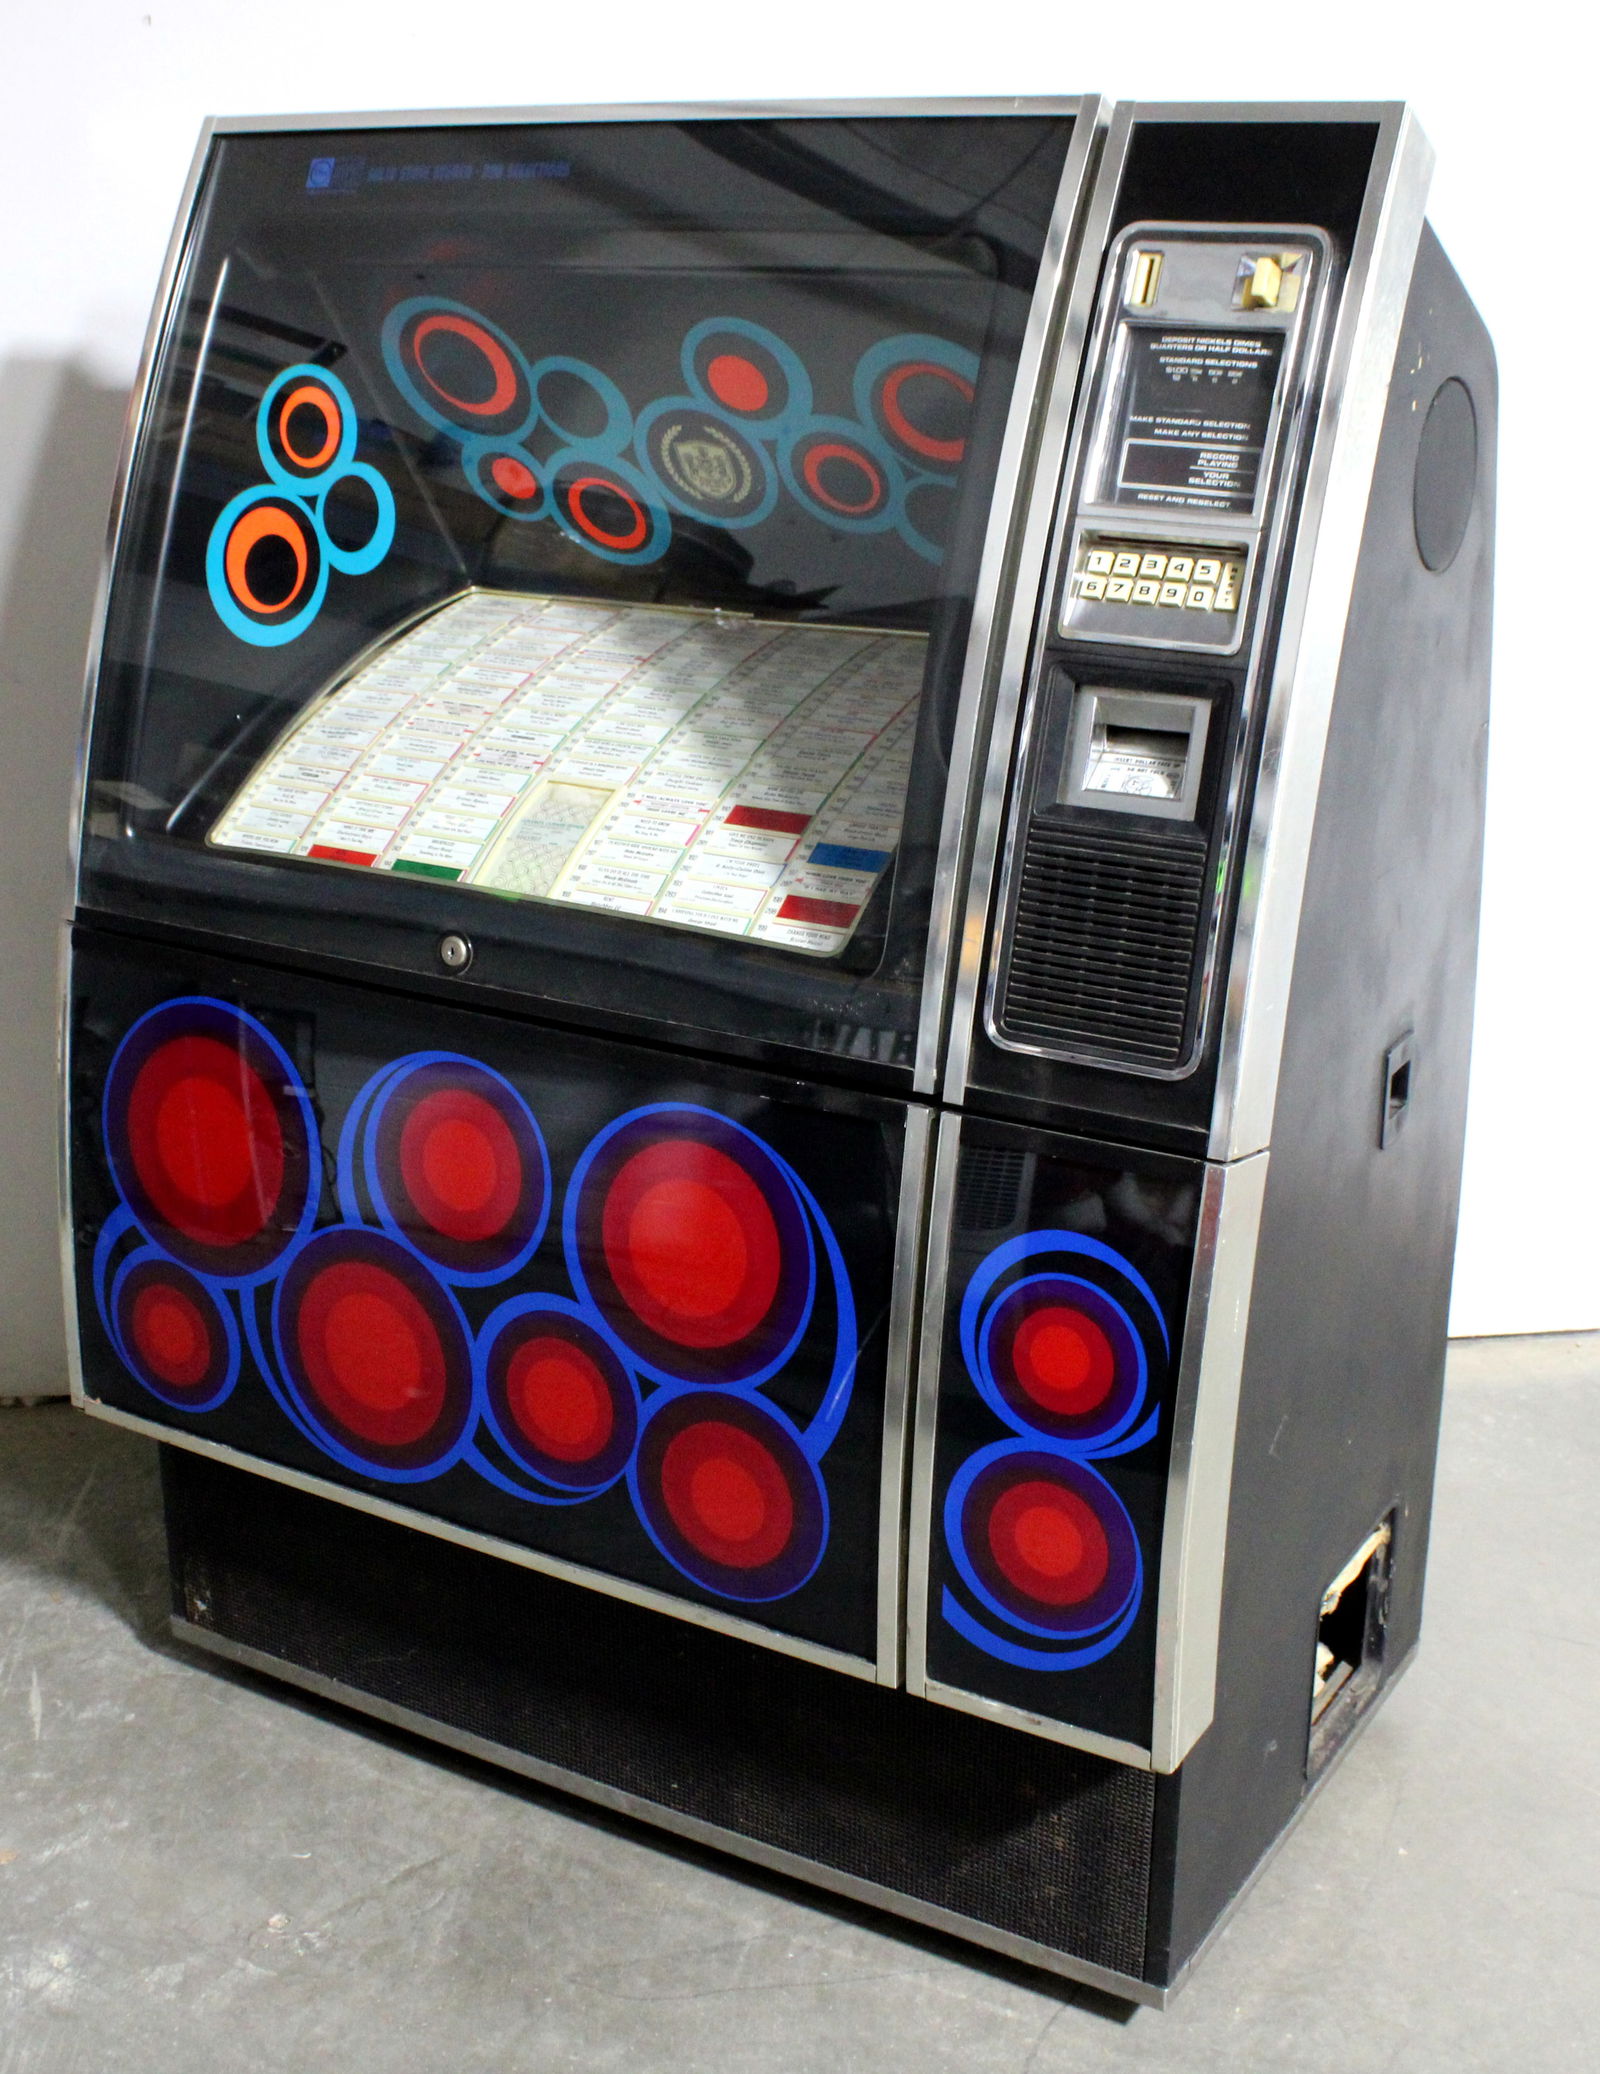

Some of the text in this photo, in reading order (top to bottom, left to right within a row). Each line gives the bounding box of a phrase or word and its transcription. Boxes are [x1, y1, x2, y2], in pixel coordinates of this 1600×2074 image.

[1150, 342, 1193, 352] QUARTERS
[1194, 344, 1208, 352] OR
[1208, 345, 1231, 354] HALF
[1162, 336, 1262, 348] DEPOSIT NICKELS DIMES
[1159, 356, 1259, 369] STANDARD SELECTIONS
[1129, 415, 1251, 430] MAKE STANDARD SELECTION
[1153, 427, 1249, 441] MAKE ANY SELECTION
[1199, 451, 1240, 461] RECORD
[1197, 459, 1238, 469] PLAYING
[1203, 471, 1230, 480] YOUR
[1188, 476, 1241, 488] SELECTION
[1137, 493, 1231, 508] RESET AND RESELECT
[1096, 556, 1211, 574] 1 2 3 4 5
[1086, 581, 1098, 591] 6
[1113, 583, 1124, 592] 7
[1139, 585, 1151, 595] 8
[1166, 588, 1178, 598] 9
